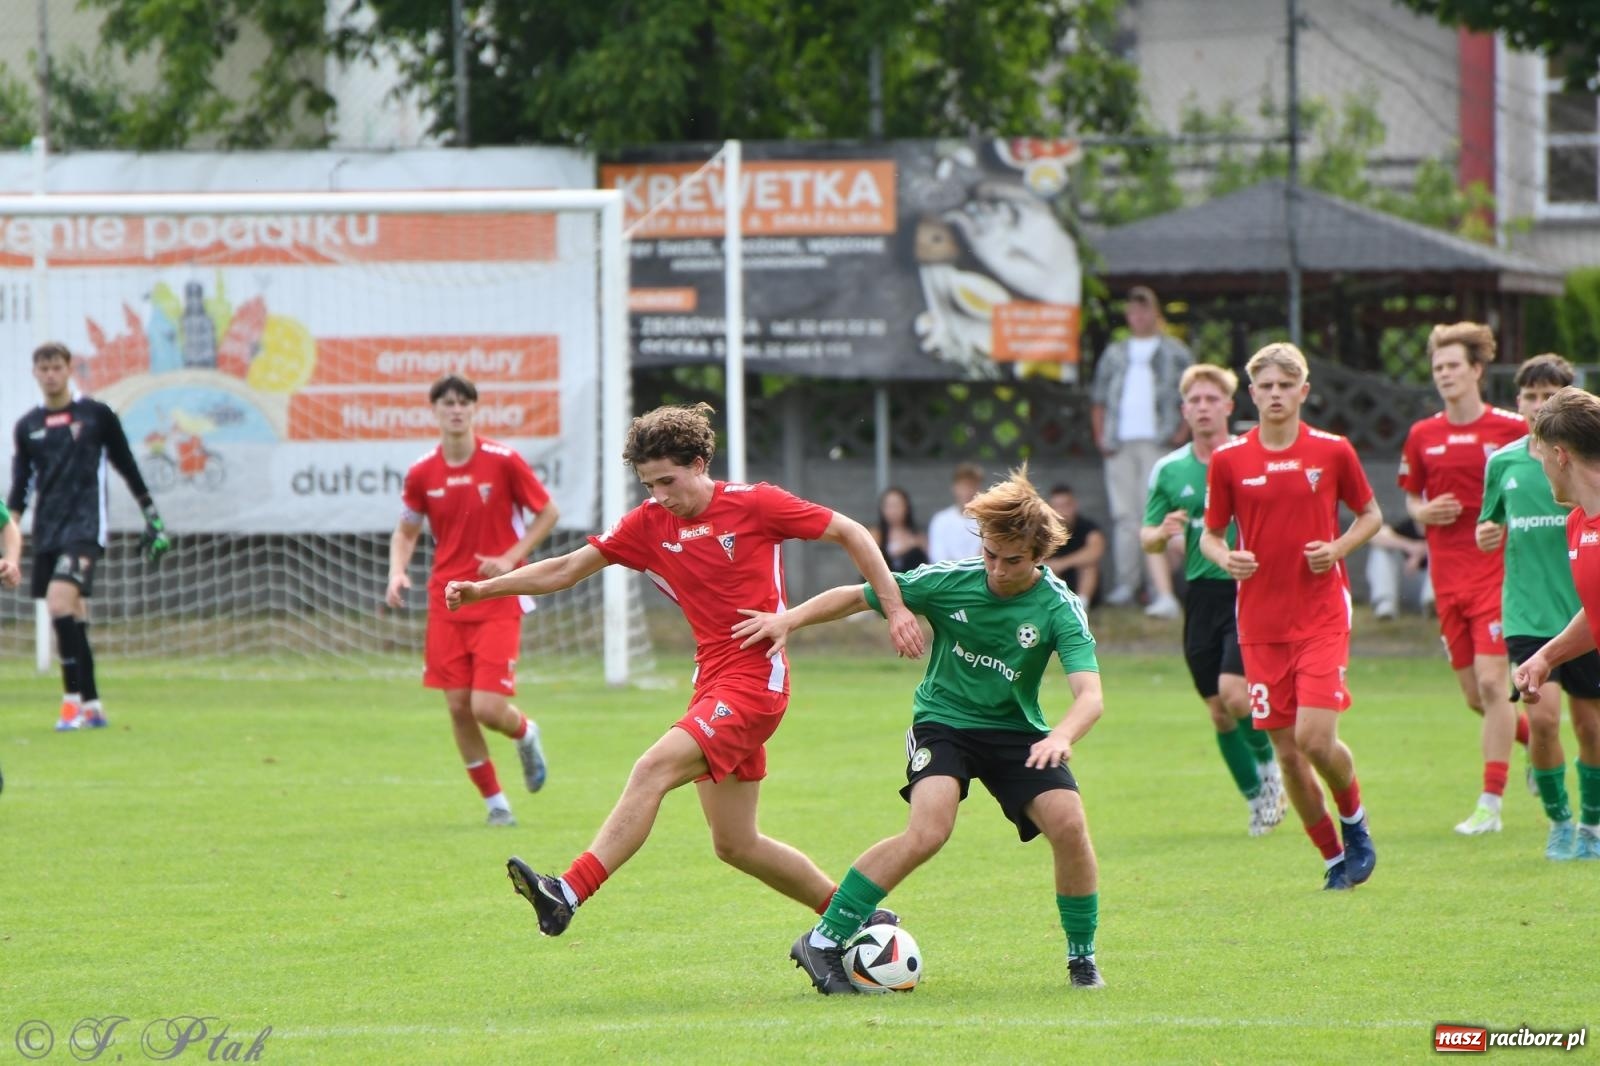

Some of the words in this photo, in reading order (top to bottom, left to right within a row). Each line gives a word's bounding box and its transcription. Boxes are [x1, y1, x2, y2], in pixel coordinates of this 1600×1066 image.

[614, 170, 882, 212] KREWETKA
[0, 213, 126, 249] enie
[680, 527, 710, 540] Betclic
[1511, 515, 1566, 532] bejama
